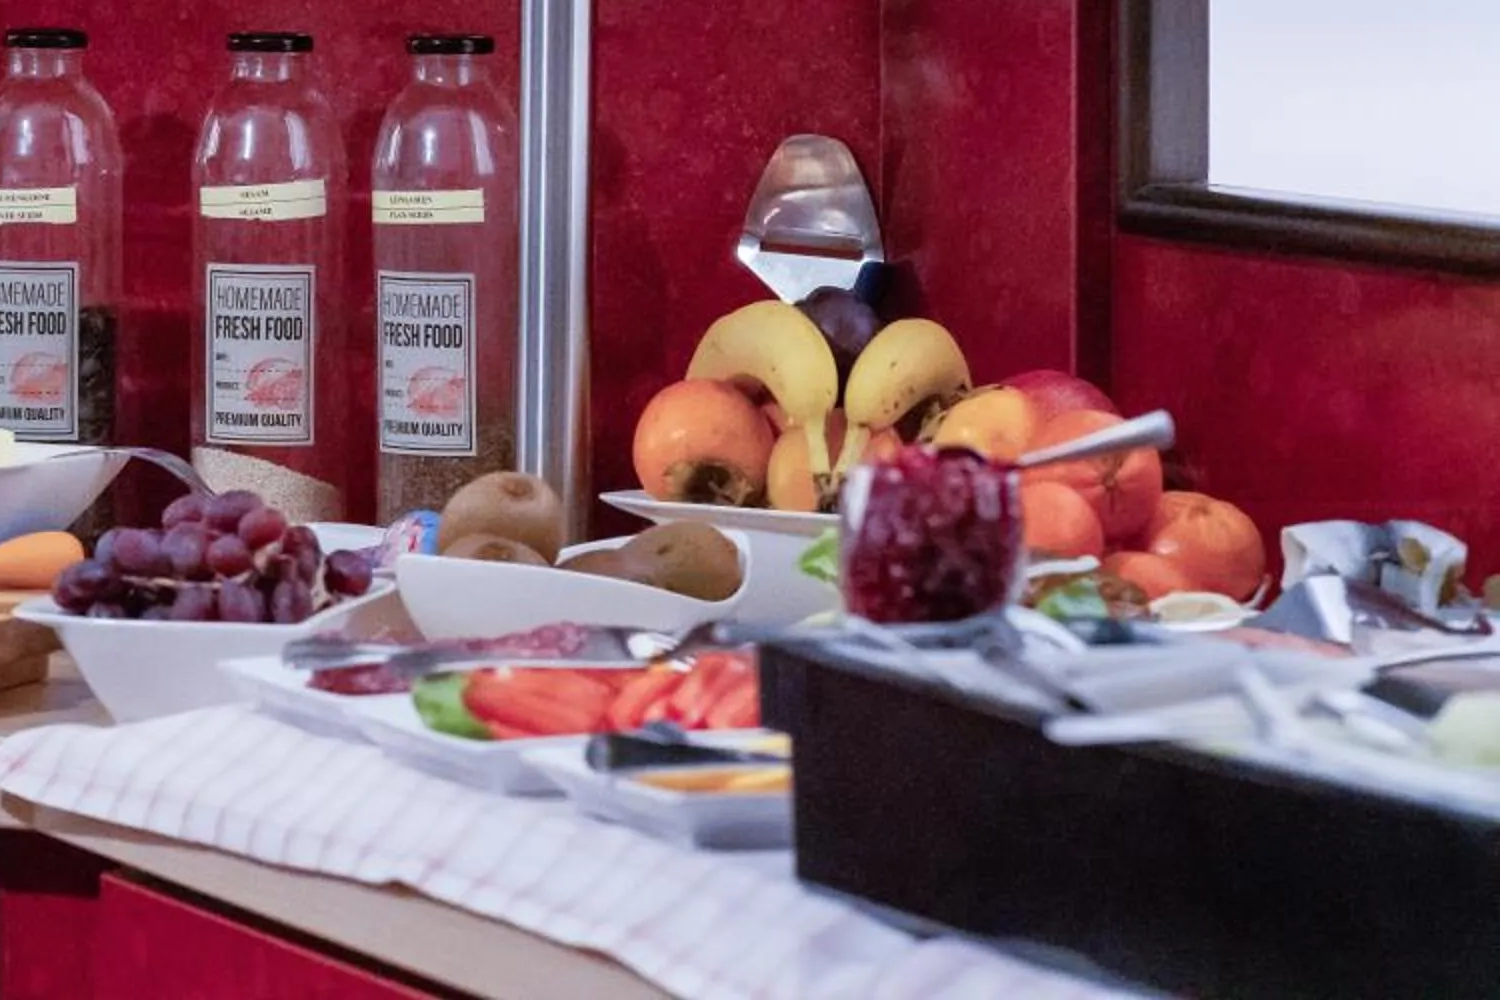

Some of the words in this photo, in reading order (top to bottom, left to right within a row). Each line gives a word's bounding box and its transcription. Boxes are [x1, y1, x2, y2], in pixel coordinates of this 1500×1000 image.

[216, 285, 302, 311] HOMEMADE
[384, 293, 461, 319] HOMEMADE
[28, 311, 67, 336] FOOD
[215, 315, 261, 341] FRESH
[266, 316, 303, 341] FOOD
[383, 321, 420, 348] FRESH
[424, 324, 463, 349] FOOD
[24, 407, 65, 422] QUALITY
[216, 411, 259, 427] PREMIUM
[261, 413, 302, 428] QUALITY
[383, 419, 419, 436] PREMIUM
[421, 421, 463, 438] QUALITY
